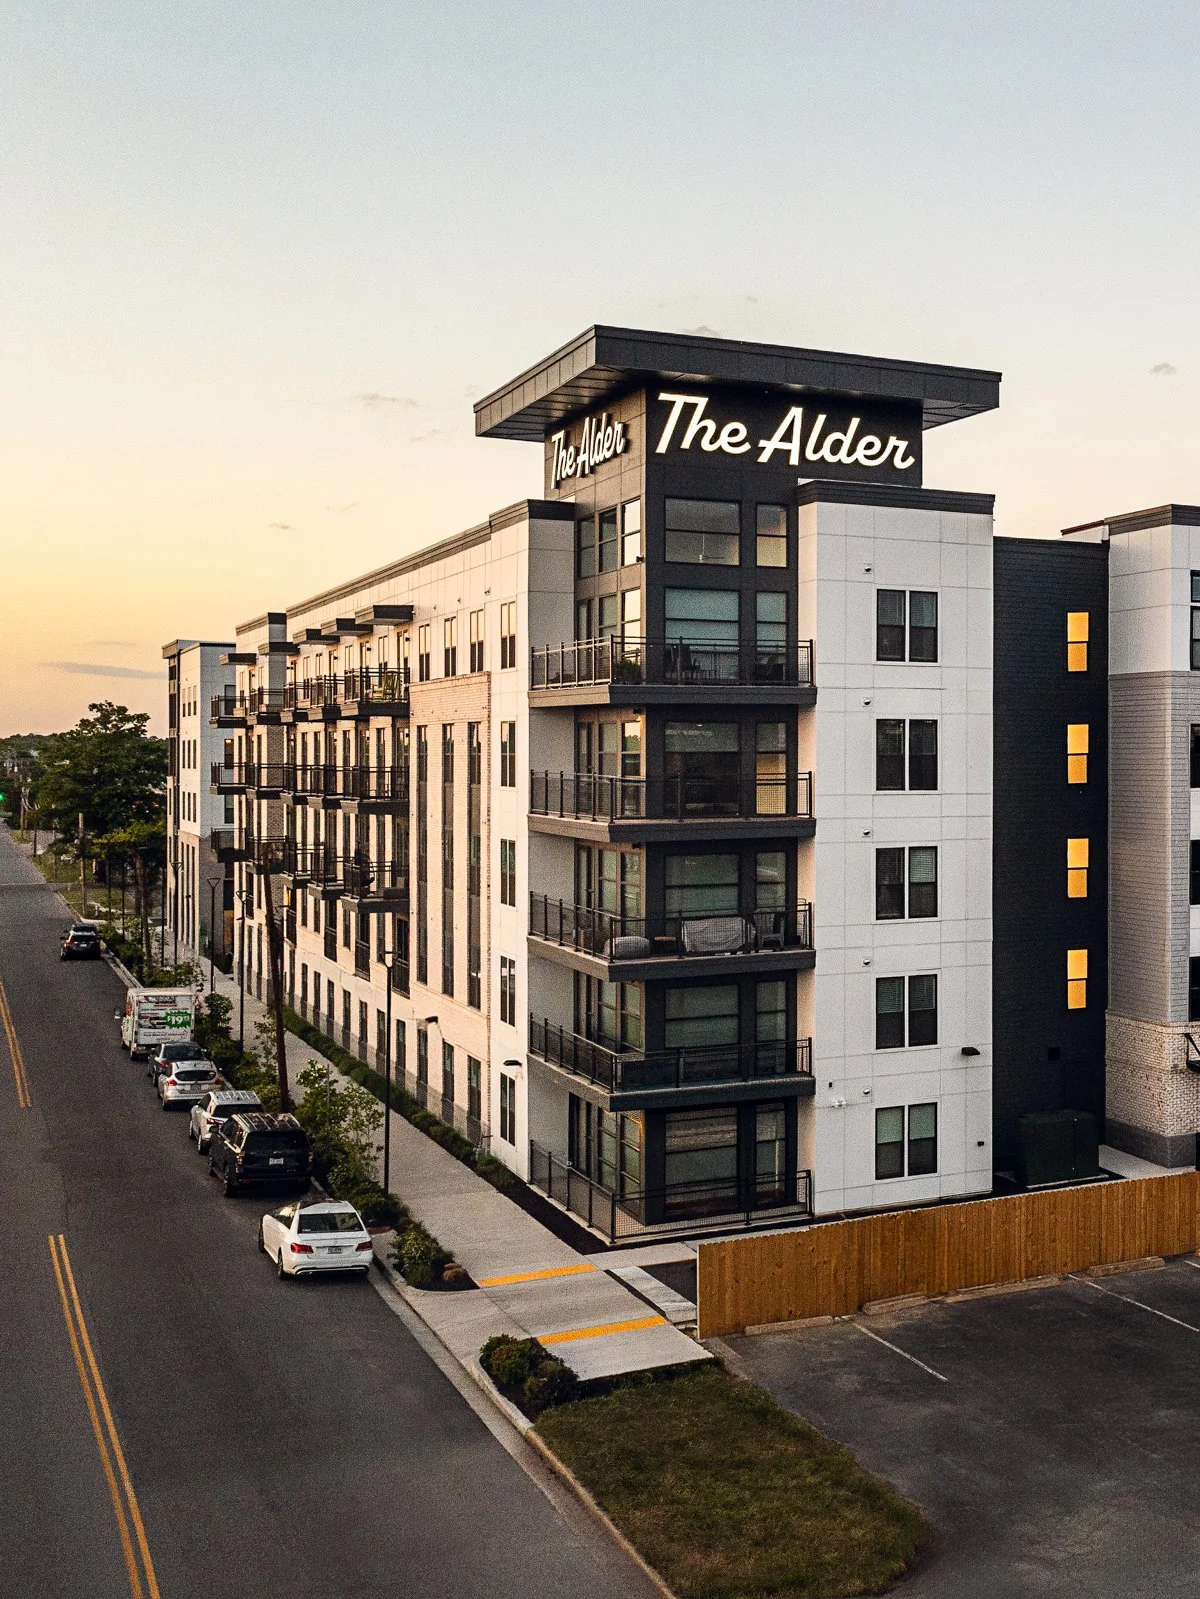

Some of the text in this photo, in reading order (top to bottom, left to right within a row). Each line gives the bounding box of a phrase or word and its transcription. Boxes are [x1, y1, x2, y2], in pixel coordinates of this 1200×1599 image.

[551, 412, 625, 489] The Alder
[656, 393, 915, 469] The Alder
